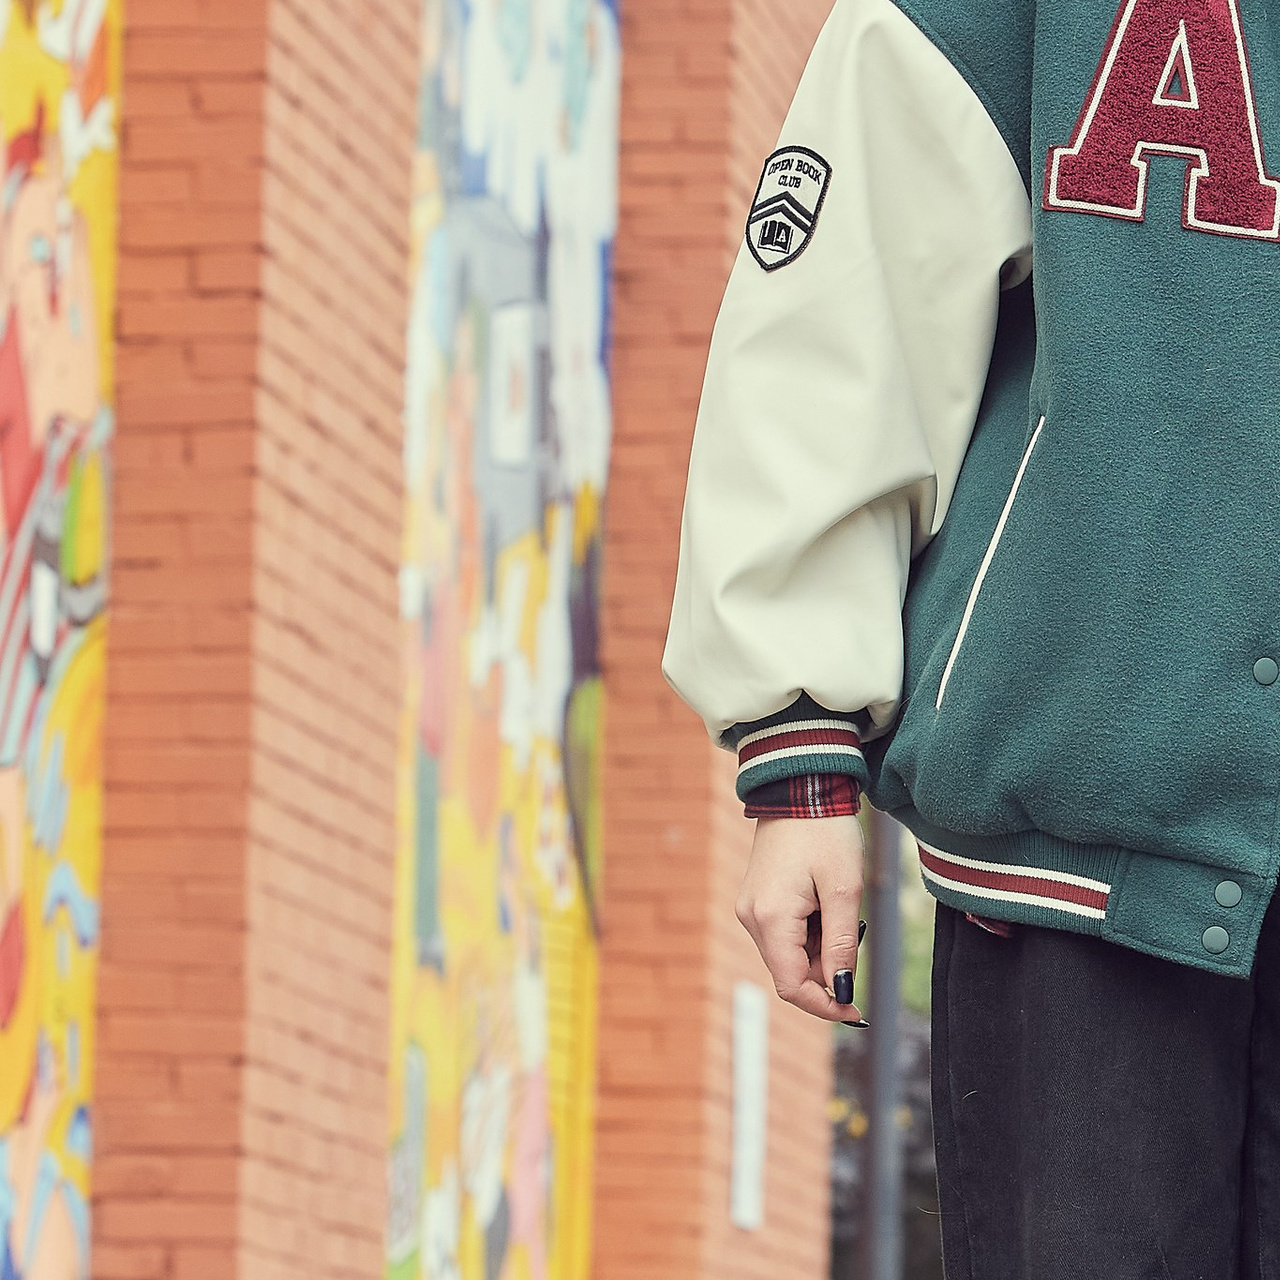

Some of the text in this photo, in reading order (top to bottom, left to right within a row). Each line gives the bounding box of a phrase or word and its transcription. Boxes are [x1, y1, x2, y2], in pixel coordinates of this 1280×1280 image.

[768, 158, 822, 186] OPEN BOOK
[778, 175, 802, 189] CLUB
